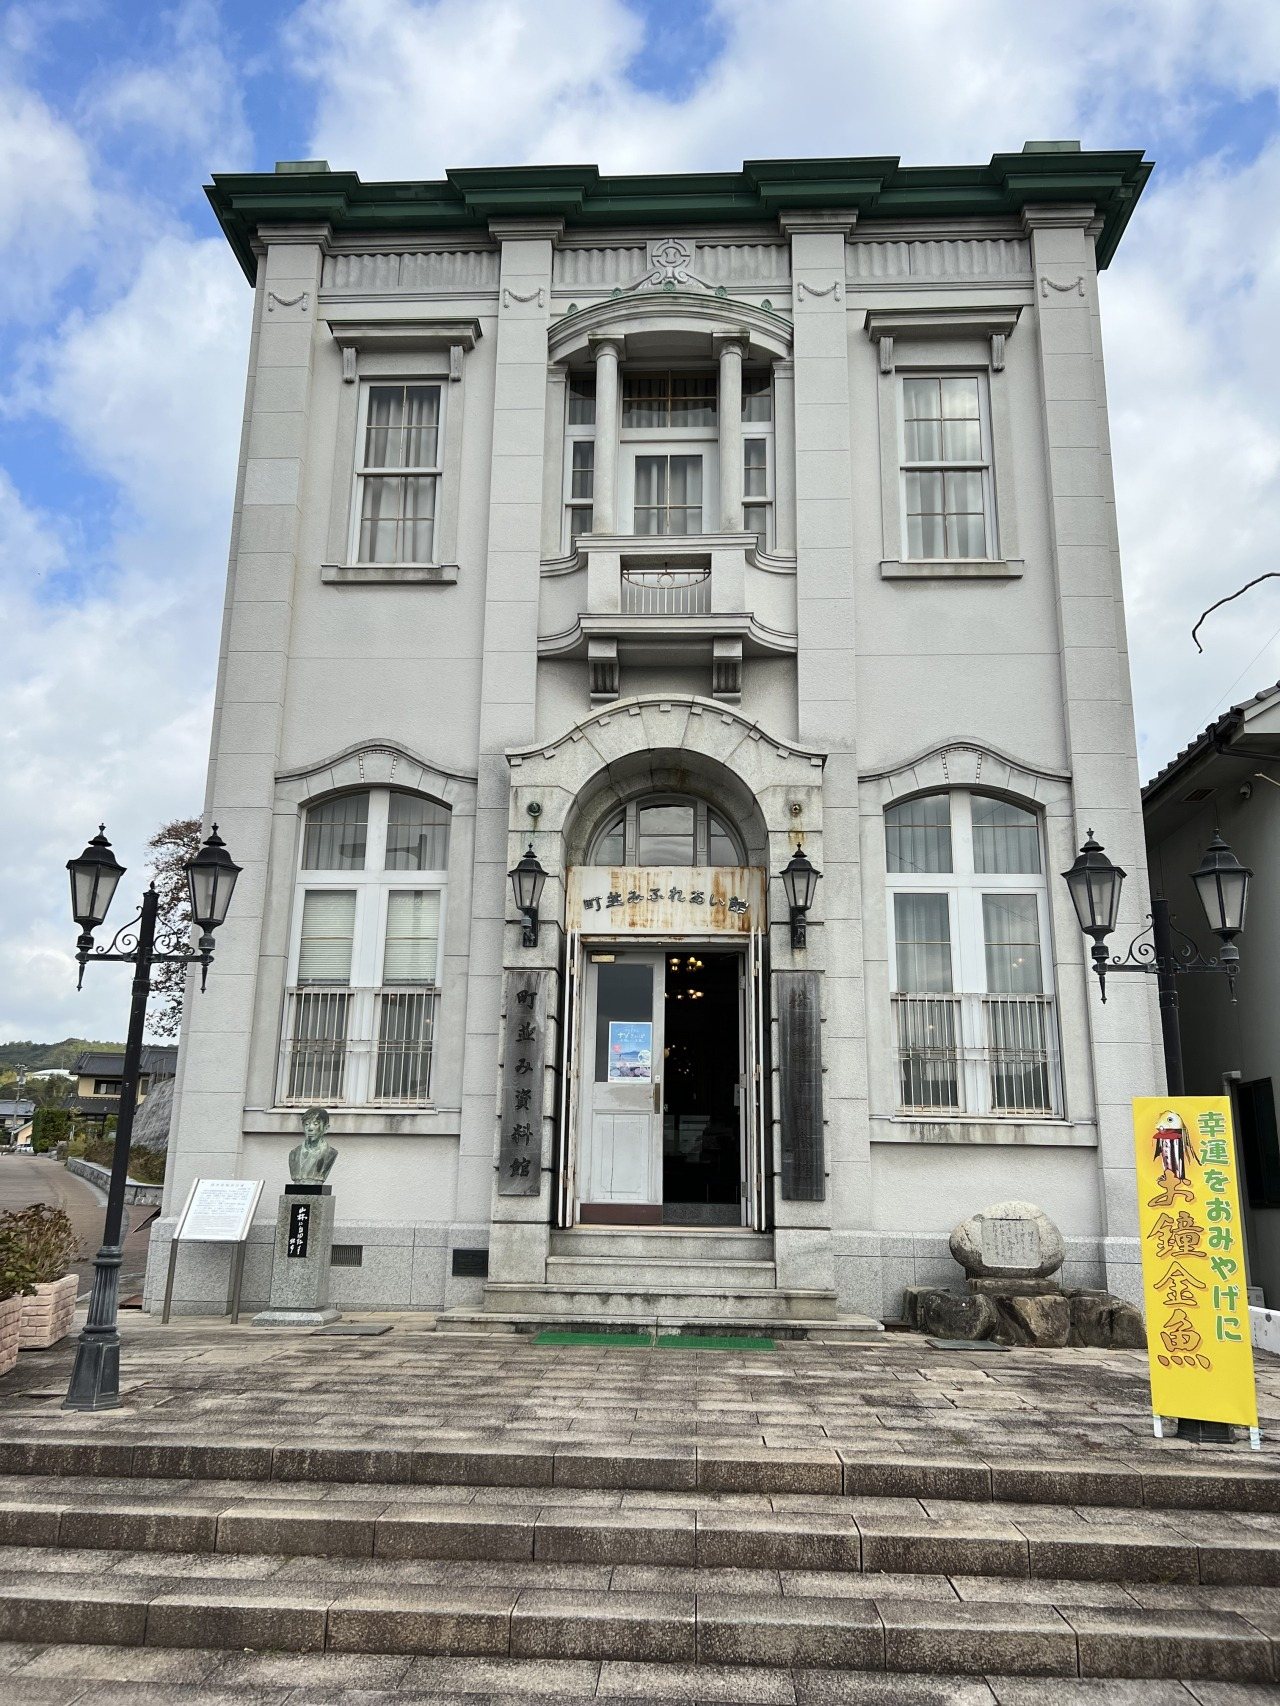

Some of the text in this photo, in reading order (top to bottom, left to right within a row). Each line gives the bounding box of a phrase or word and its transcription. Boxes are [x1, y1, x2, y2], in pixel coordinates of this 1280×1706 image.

[583, 886, 750, 914] 町並みふれあい館
[509, 989, 538, 1178] 町並み資料館
[1147, 1168, 1211, 1370] お鐘金魚
[1197, 1111, 1243, 1343] 幸運をおみやげに
